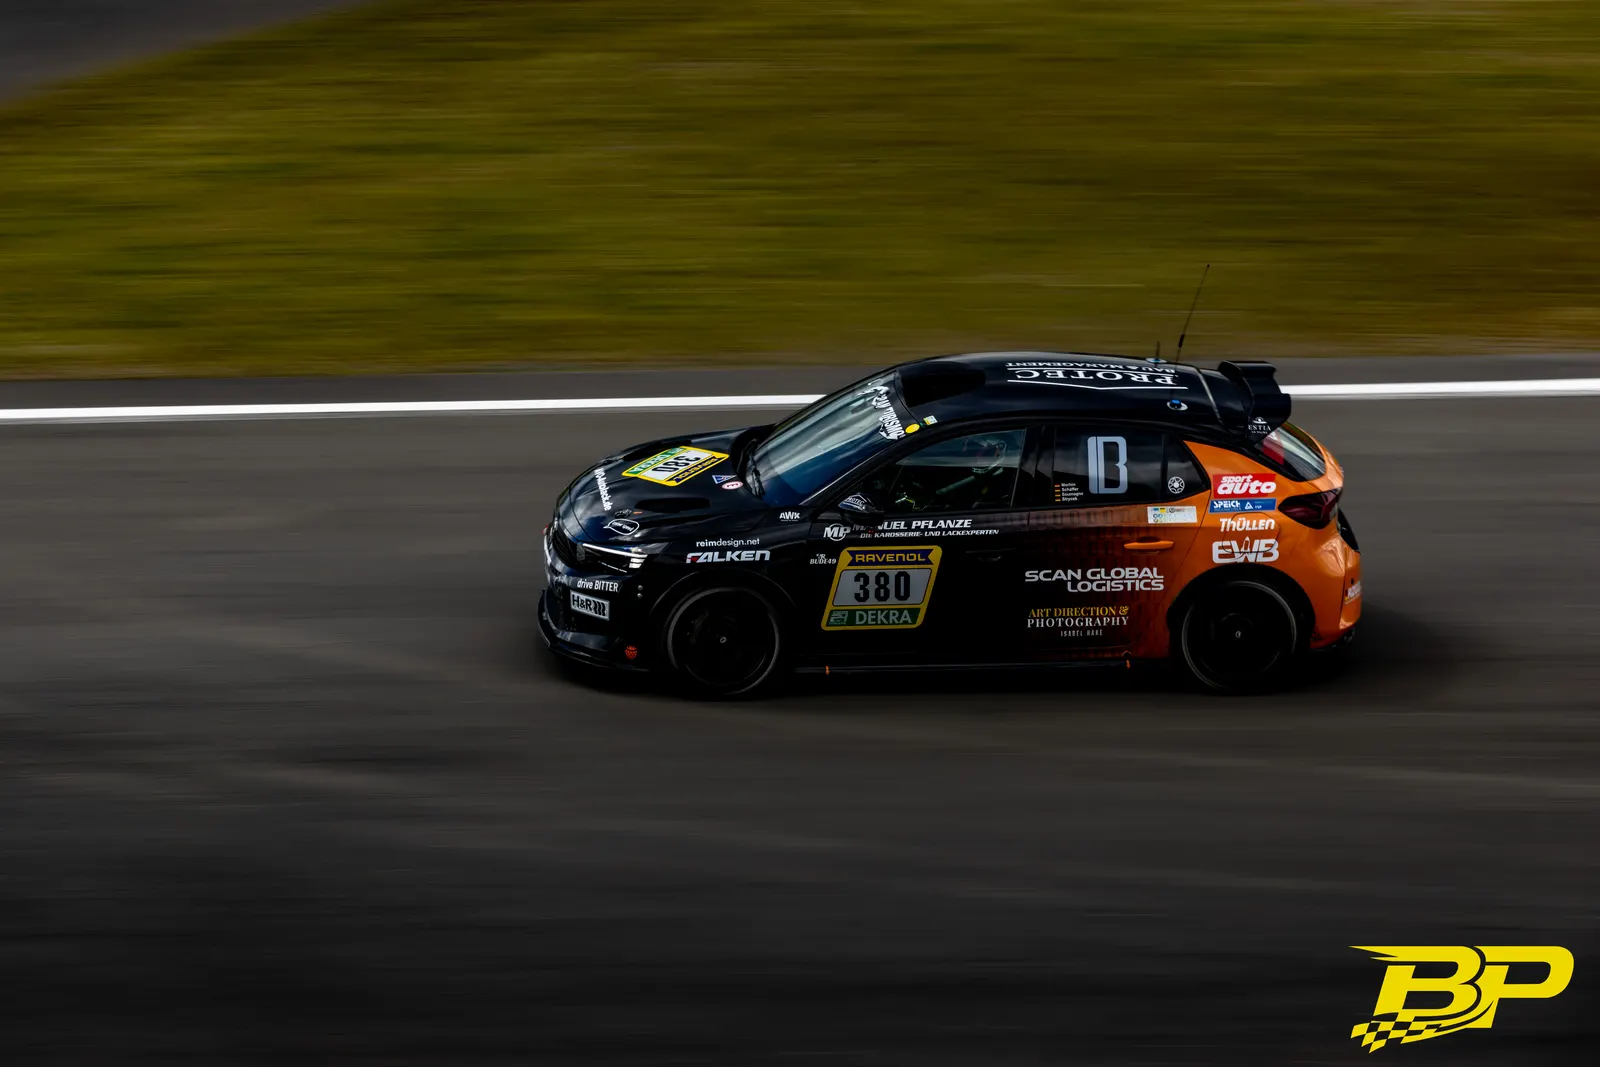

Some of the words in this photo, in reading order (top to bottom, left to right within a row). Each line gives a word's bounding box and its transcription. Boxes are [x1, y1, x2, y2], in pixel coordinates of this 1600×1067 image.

[1005, 361, 1123, 369] MANAGEMENT
[1015, 370, 1177, 385] PROTEC
[652, 456, 701, 472] 380
[1221, 475, 1253, 483] sport
[1217, 480, 1277, 495] auto
[911, 519, 973, 529] PFLANZE
[823, 525, 851, 539] MP
[874, 530, 923, 538] KAROSSERIE-
[924, 529, 940, 537] UND
[942, 528, 1000, 537] LACKEXPERTEN
[695, 538, 760, 547] reimdesign.net
[686, 550, 770, 564] FALKEN
[1212, 537, 1279, 564] EWB
[855, 553, 926, 563] RAVENOL
[1025, 569, 1082, 582] SCAN
[1086, 567, 1164, 580] GLOBAL
[576, 578, 593, 589] drive
[594, 580, 619, 592] BITTER
[853, 571, 911, 602] 380
[1067, 579, 1164, 593] LOGISTICS
[572, 594, 592, 611] H&R
[855, 609, 912, 625] DEKRA
[1028, 608, 1052, 618] ART
[1053, 606, 1116, 617] DIRECTION
[1118, 605, 1130, 616] &
[1027, 616, 1129, 628] PHOTOGRAPHY
